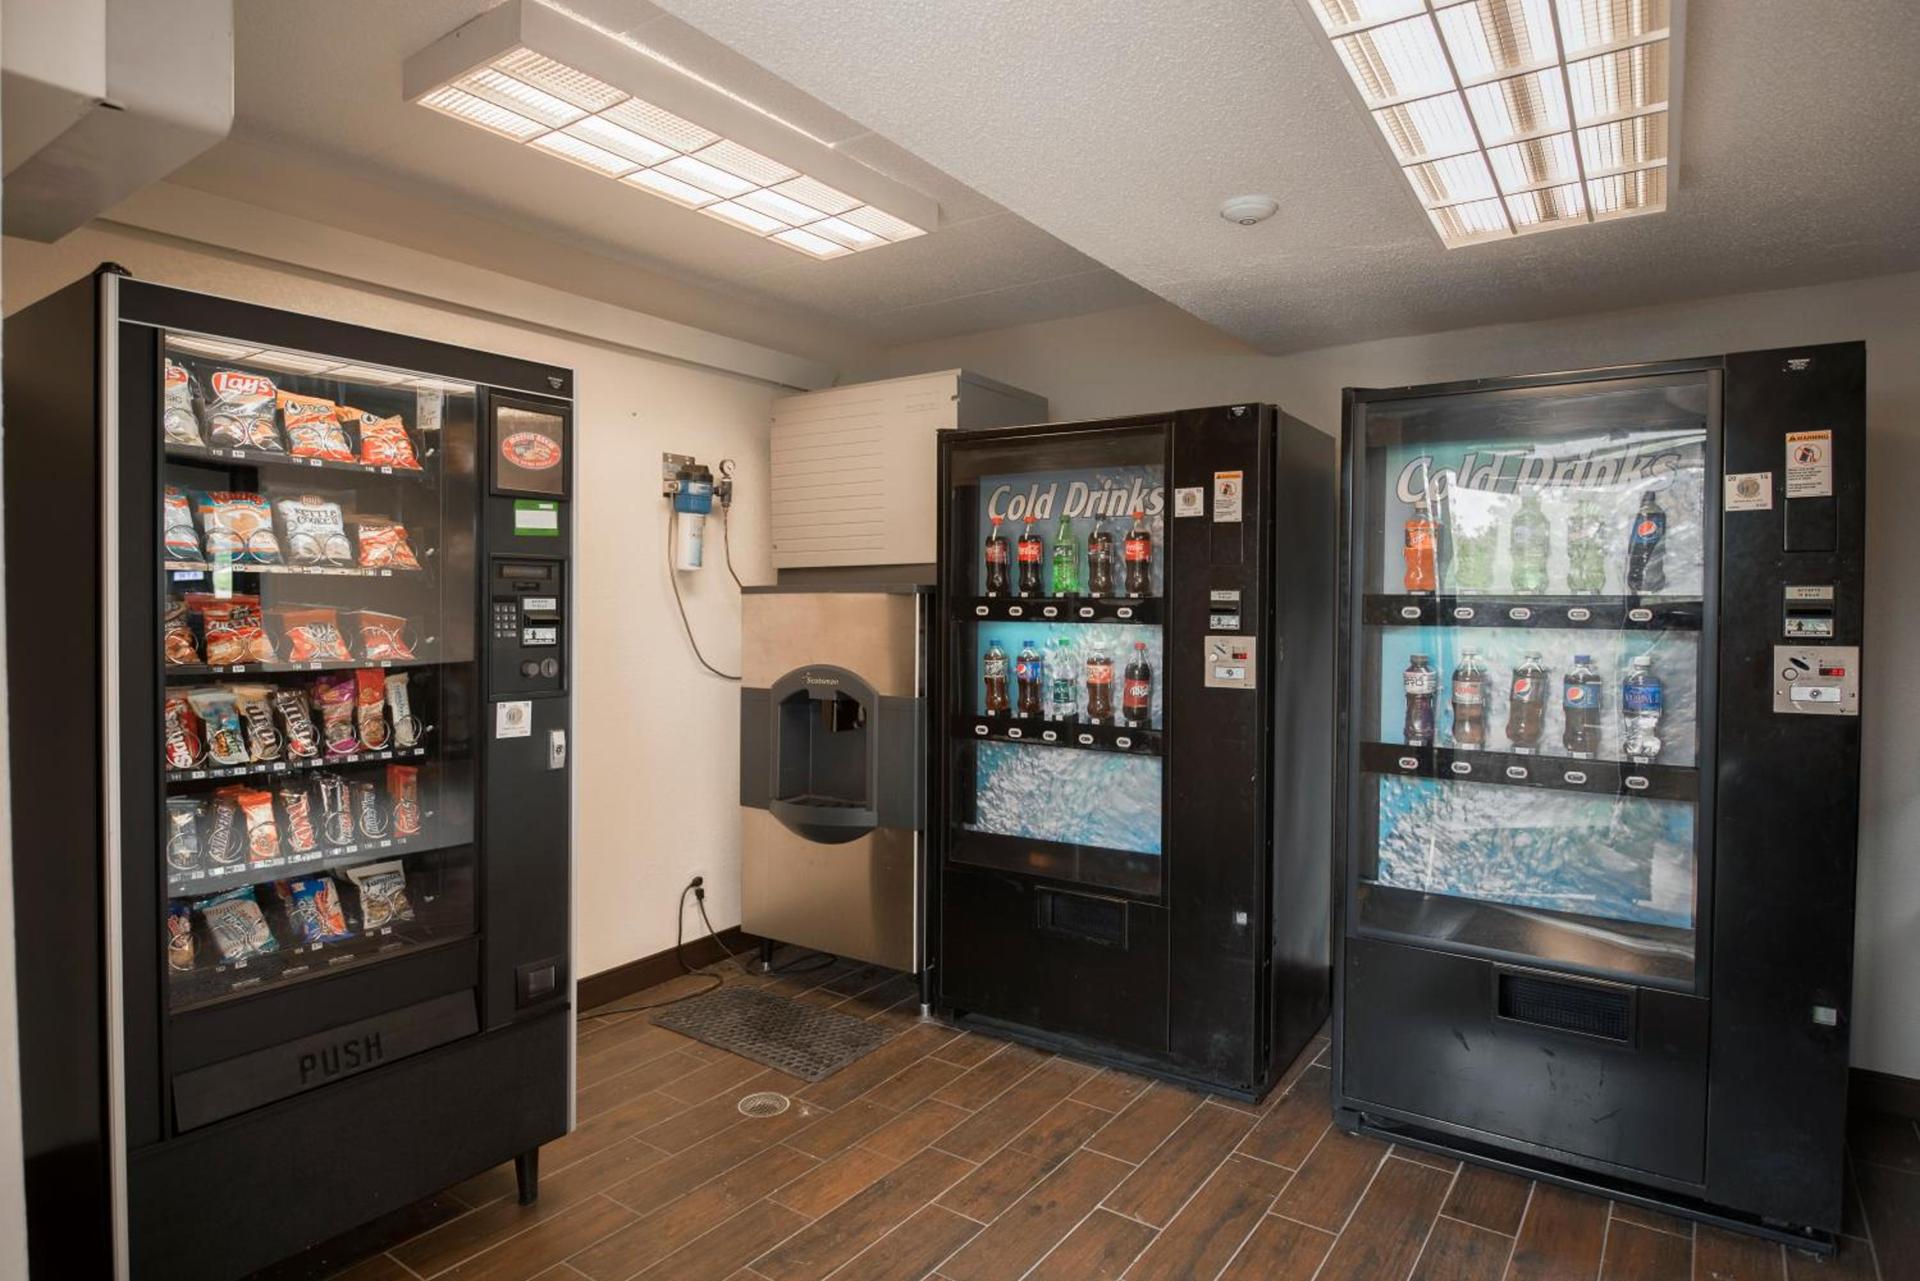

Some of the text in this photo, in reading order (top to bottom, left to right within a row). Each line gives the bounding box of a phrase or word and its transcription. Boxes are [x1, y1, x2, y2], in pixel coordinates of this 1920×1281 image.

[988, 483, 1057, 521] Cold
[1064, 477, 1164, 518] Drinks
[1397, 449, 1682, 503] Cold Drinks
[299, 1031, 384, 1084] PUSH
